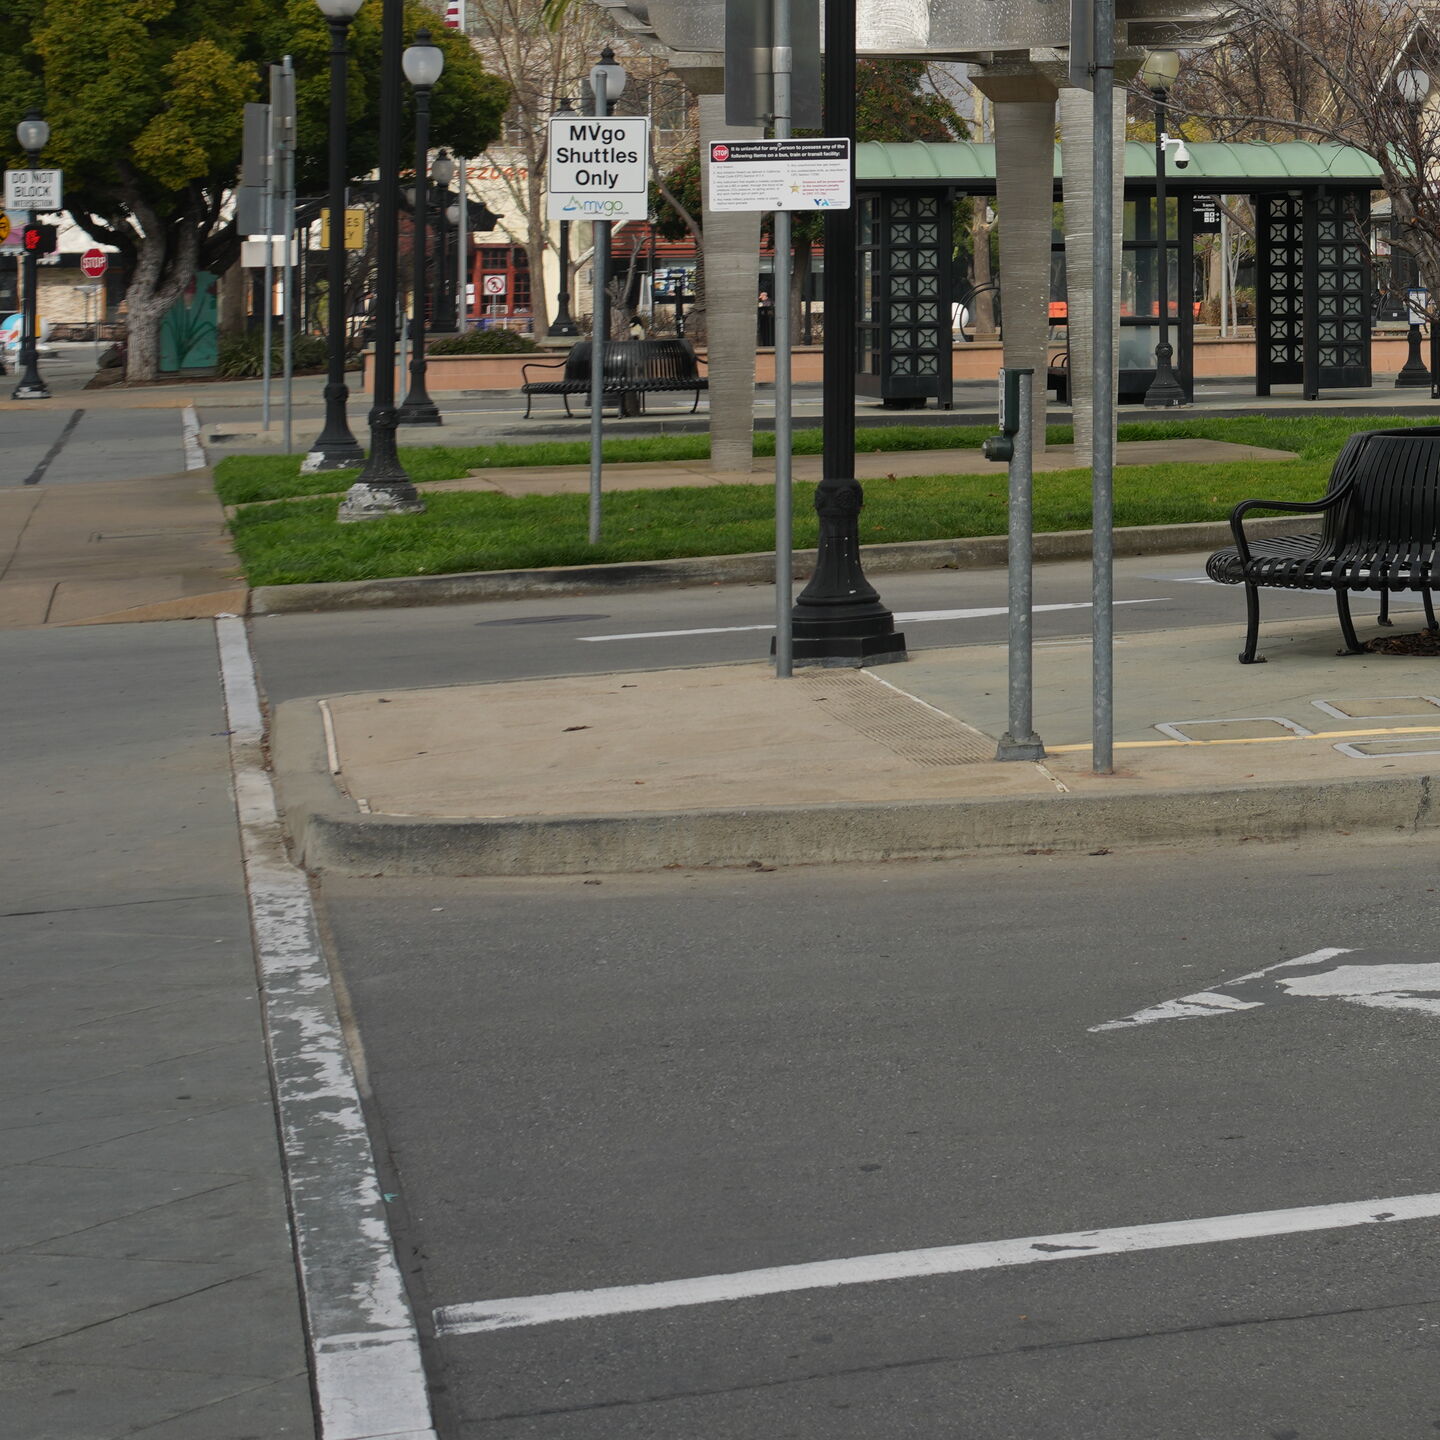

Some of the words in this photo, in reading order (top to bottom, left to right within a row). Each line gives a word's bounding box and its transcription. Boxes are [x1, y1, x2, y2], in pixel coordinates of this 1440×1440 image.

[569, 125, 626, 145] MVgo
[556, 147, 638, 164] Shuttles
[12, 172, 27, 184] DO
[31, 172, 54, 184] NOT
[575, 170, 619, 189] Only
[15, 186, 51, 197] BLOCK
[583, 200, 623, 217] mvgo
[83, 257, 106, 268] STOP
